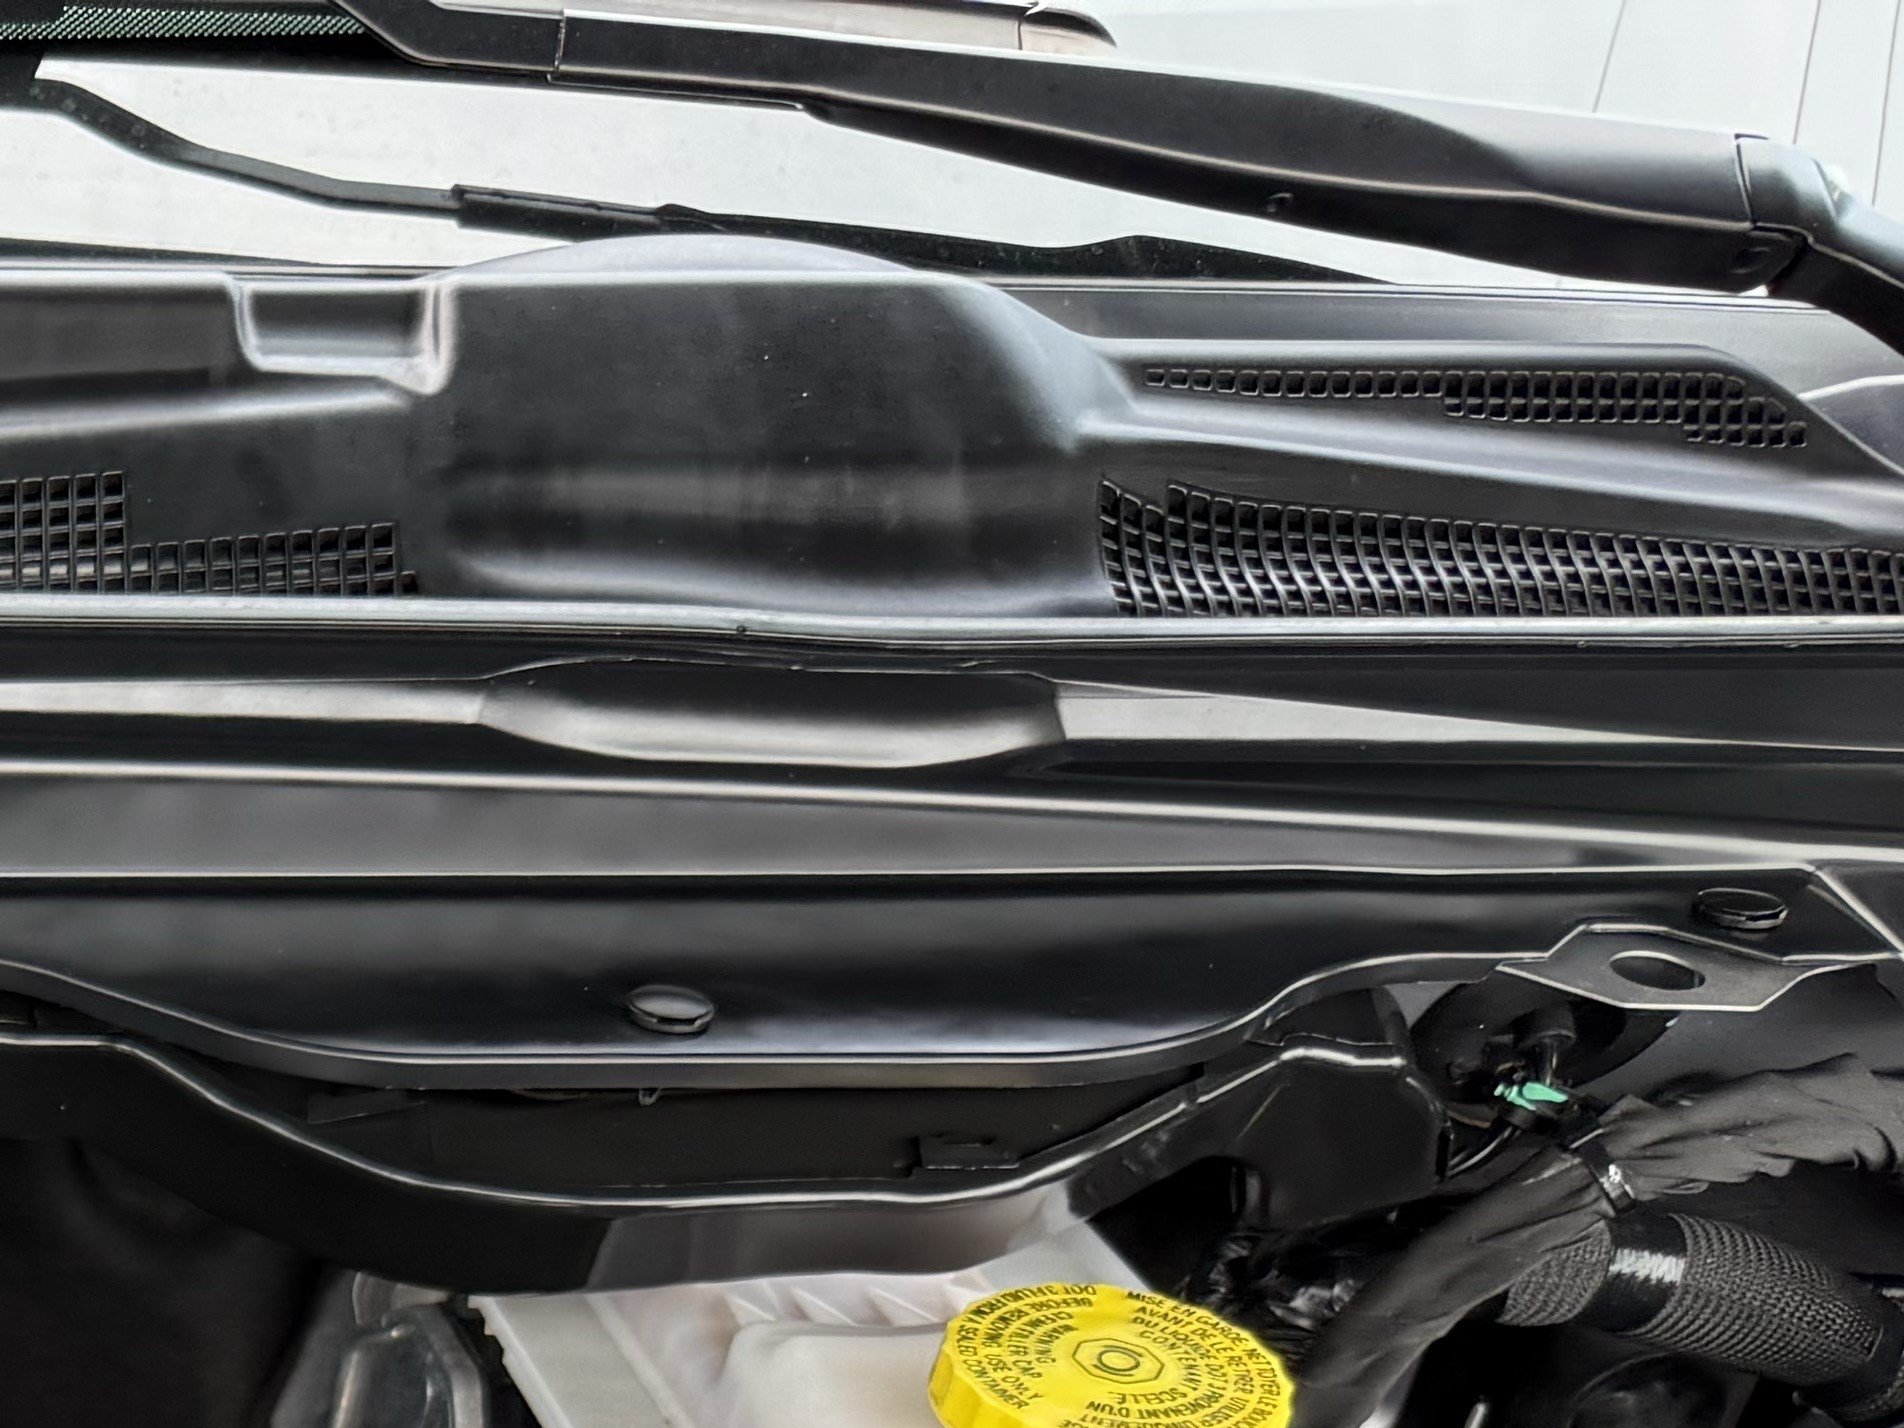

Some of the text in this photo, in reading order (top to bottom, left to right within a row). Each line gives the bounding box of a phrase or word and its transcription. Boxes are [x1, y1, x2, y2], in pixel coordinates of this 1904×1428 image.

[1059, 1285, 1098, 1295] DOT
[1020, 1296, 1095, 1314] BEFORE
[1130, 1314, 1161, 1330] DU
[1135, 1303, 1195, 1329] AVANT
[956, 1322, 982, 1357] SEALED
[1005, 1325, 1037, 1357] FILLER
[1187, 1326, 1219, 1341] DE
[1206, 1340, 1238, 1354] LE
[982, 1352, 1013, 1373] USE
[1010, 1359, 1045, 1380] CAP
[1136, 1328, 1204, 1392] CONTENANT
[1202, 1362, 1228, 1384] DOT
[997, 1374, 1046, 1403] ONLY
[1083, 1398, 1131, 1419] D'UN
[1132, 1387, 1225, 1420] PROVENANT
[1192, 1394, 1250, 1428] UTILISER
[1254, 1394, 1280, 1409] LE
